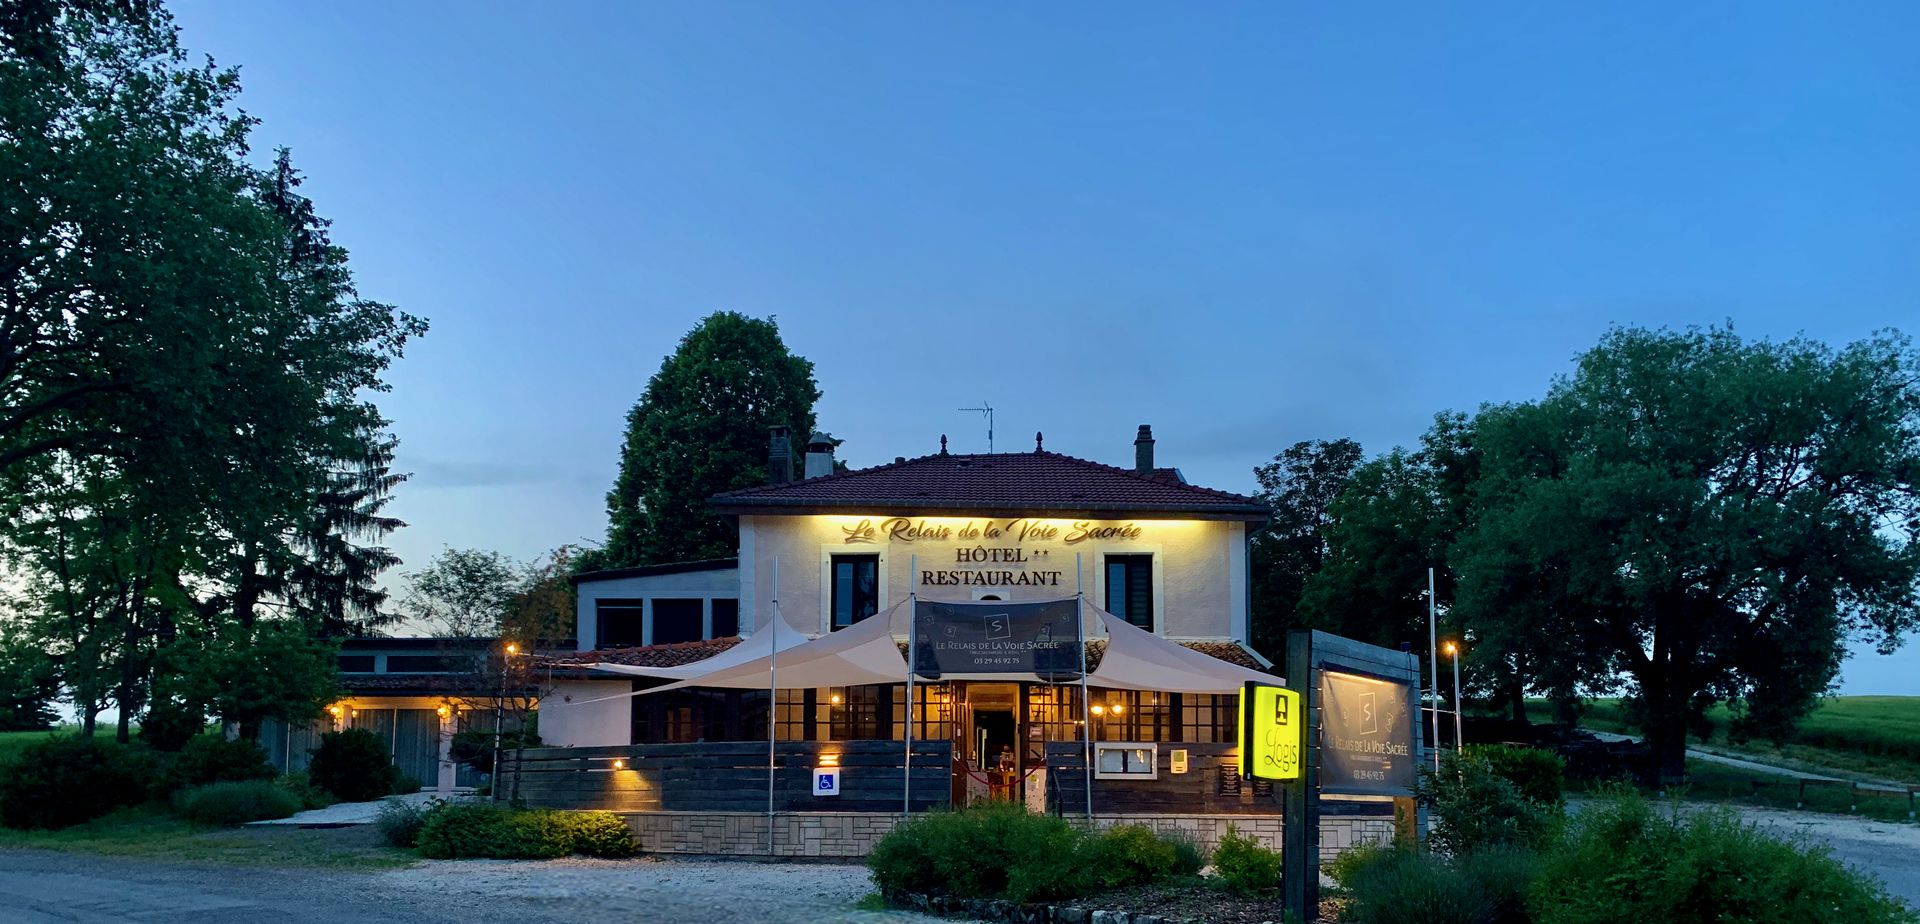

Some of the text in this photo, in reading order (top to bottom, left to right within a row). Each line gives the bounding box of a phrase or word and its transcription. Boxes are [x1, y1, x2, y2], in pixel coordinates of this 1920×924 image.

[842, 518, 1142, 543] Le Relais de la Voie Sacrée
[955, 545, 1028, 562] HÔTEL
[921, 570, 1062, 586] RESTAURANT
[974, 657, 1020, 665] 03 29 45 92 75
[1264, 727, 1297, 772] Logis
